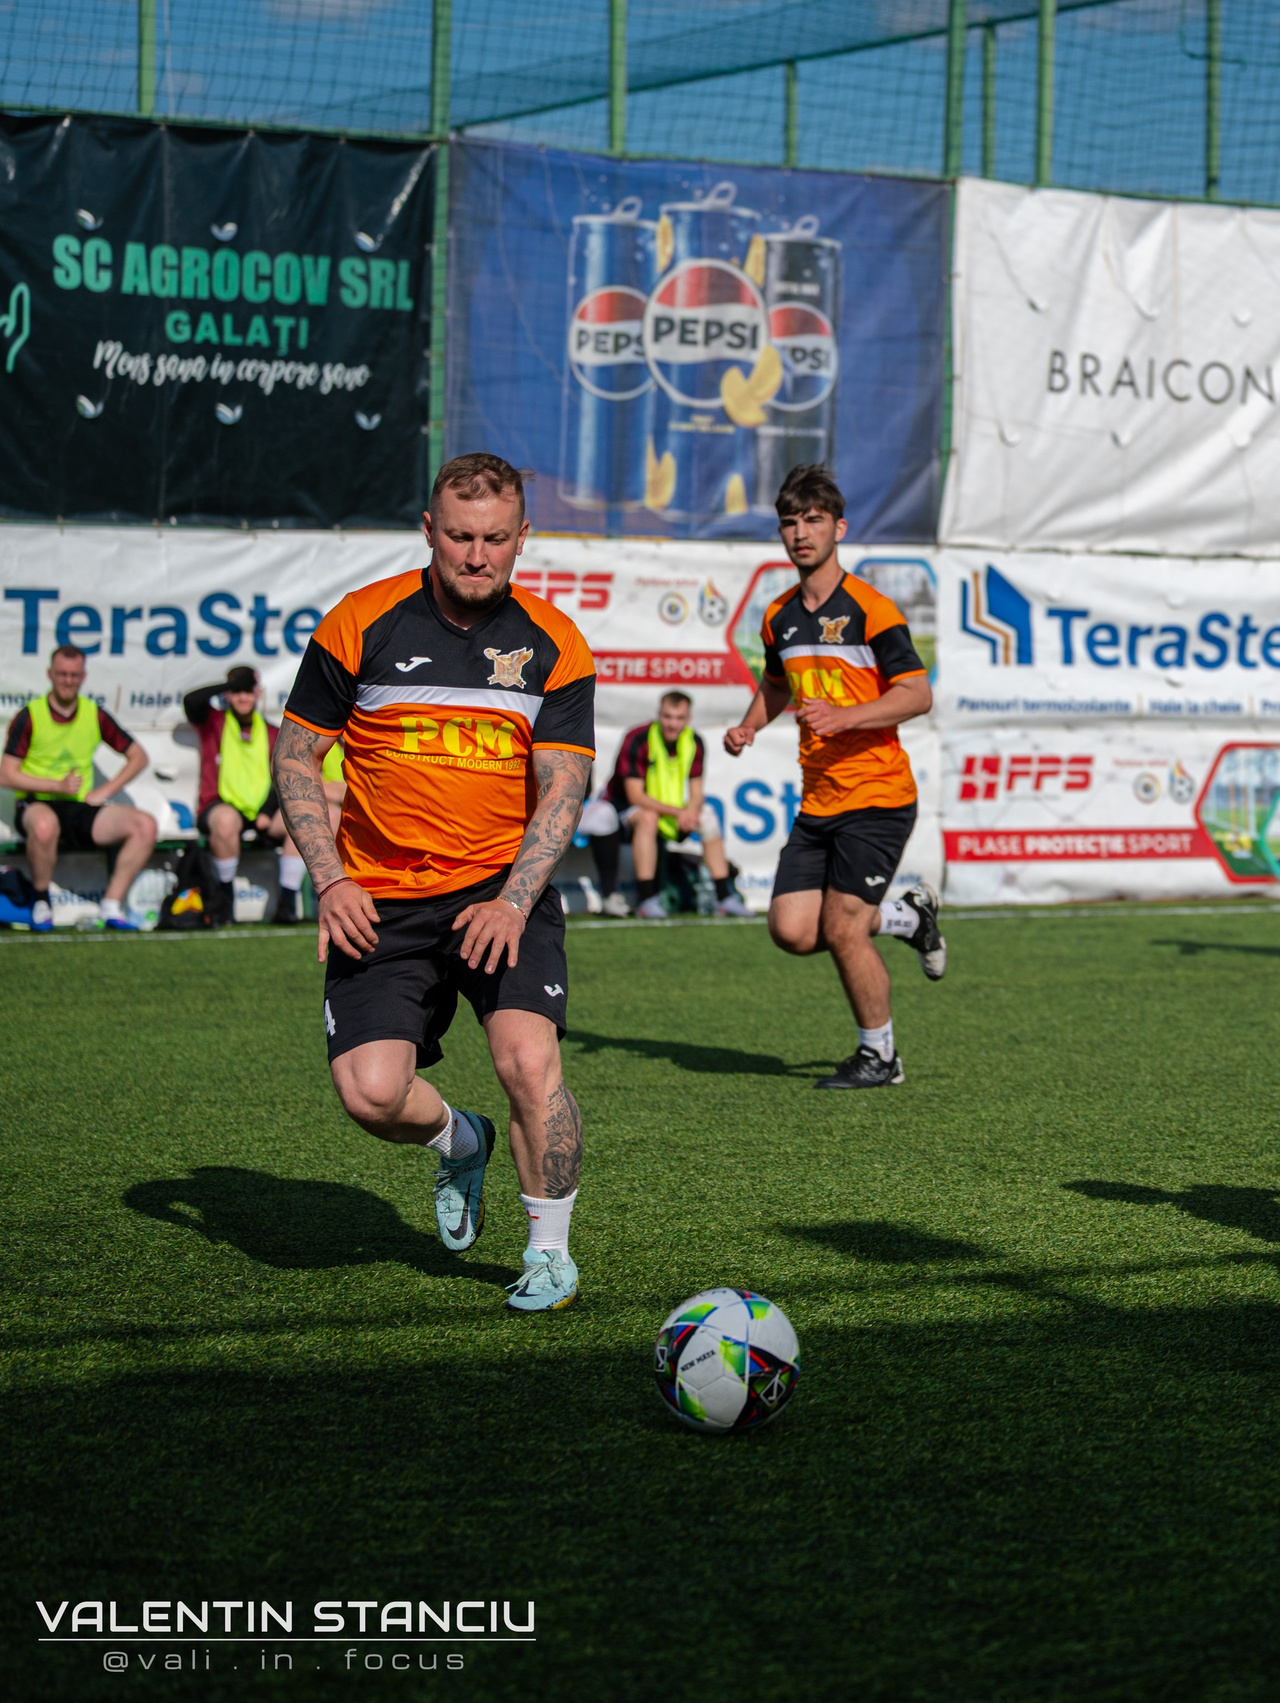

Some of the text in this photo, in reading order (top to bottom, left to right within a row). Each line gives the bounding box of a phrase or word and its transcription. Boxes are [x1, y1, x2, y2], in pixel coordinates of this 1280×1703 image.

[52, 234, 414, 312] SC AGROCOV SRL
[653, 316, 759, 351] PEPSI
[783, 344, 831, 371] PSI
[153, 353, 209, 387] sana
[210, 352, 236, 386] in
[319, 362, 371, 395] sano
[649, 657, 724, 679] SPORT
[400, 716, 516, 759] PCM
[386, 748, 521, 771] CONSTRUCT MODERN 1992
[1006, 756, 1093, 791] FPS
[958, 835, 1023, 857] PLASE
[1128, 833, 1193, 853] SPORT
[680, 1360, 696, 1372] NEW
